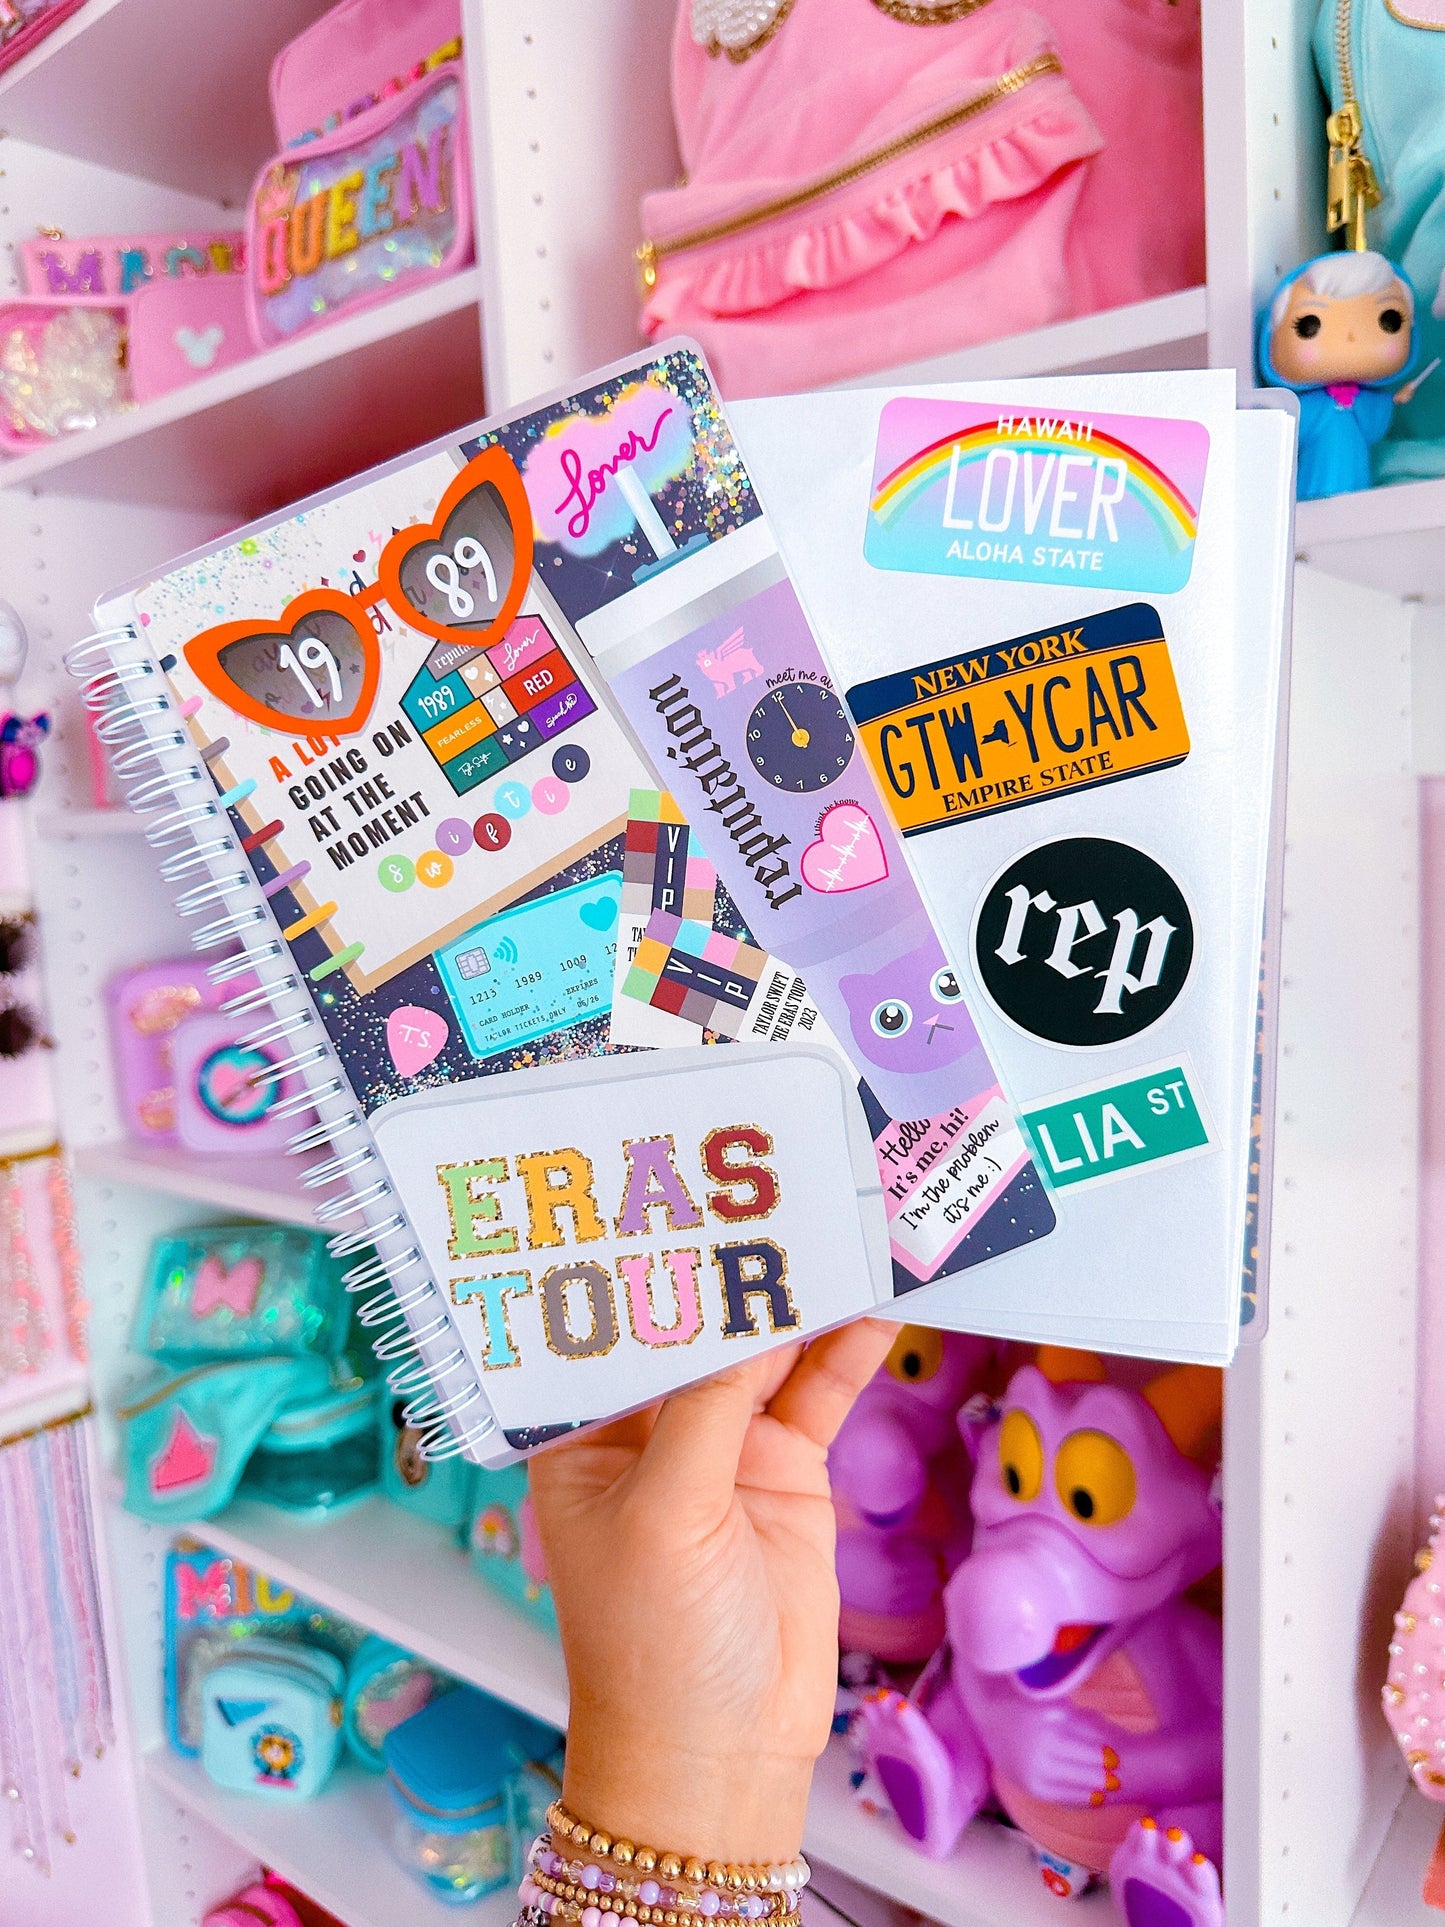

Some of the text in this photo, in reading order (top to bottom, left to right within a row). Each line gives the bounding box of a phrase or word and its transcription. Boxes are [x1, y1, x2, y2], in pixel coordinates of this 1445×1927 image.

[257, 124, 449, 294] QUEEN
[997, 414, 1094, 442] HAWAII
[942, 444, 1128, 542] LOVER
[946, 540, 1104, 571] ALOHA STATE
[280, 637, 343, 709] 19
[426, 536, 498, 618] 89
[766, 667, 795, 688] meet
[799, 670, 817, 681] me
[912, 627, 1088, 699] NEW YORK
[523, 668, 554, 696] RED
[771, 691, 785, 703] 12
[796, 685, 804, 694] 1
[819, 690, 828, 700] 2
[417, 684, 455, 719] 1989
[755, 707, 766, 718] 11
[836, 709, 845, 719] 3
[437, 716, 483, 748] FEARLESS
[748, 729, 761, 742] 10
[845, 733, 853, 742] 4
[268, 755, 293, 783] A
[288, 719, 413, 811] GOING ON
[756, 756, 765, 766] 9
[836, 756, 845, 766] 5
[649, 673, 802, 910] reputation
[774, 775, 783, 784] 8
[796, 780, 804, 789] 7
[819, 773, 828, 783] 6
[943, 751, 1114, 813] EMPIRE STATE
[308, 772, 396, 843] AT THE
[814, 812, 824, 832] think
[824, 803, 833, 813] he
[834, 799, 859, 807] knows
[326, 791, 431, 871] MOMENT
[661, 826, 680, 911] VIP
[995, 884, 1177, 1015] rep
[469, 988, 498, 1006] 1213
[514, 971, 543, 989] 1989
[559, 954, 587, 972] 1009
[565, 978, 599, 996] EXPIRES
[666, 957, 750, 1001] VIP
[479, 1004, 531, 1027] CARD HOLDER
[576, 996, 600, 1009] 06/26
[752, 971, 789, 1035] TAYLOR SWIFT
[778, 1002, 799, 1027] ERAS
[515, 1016, 546, 1031] TICKETS
[549, 1006, 566, 1020] ONLY
[798, 1007, 818, 1031] 2023
[1037, 1081, 1185, 1174] LIA ST
[887, 1107, 969, 1201] It's me, hi!
[900, 1120, 999, 1230] I'm the problem
[436, 1122, 781, 1261] ERAS
[943, 1197, 970, 1223] it's
[967, 1174, 989, 1197] me
[449, 1237, 802, 1371] TOUR
